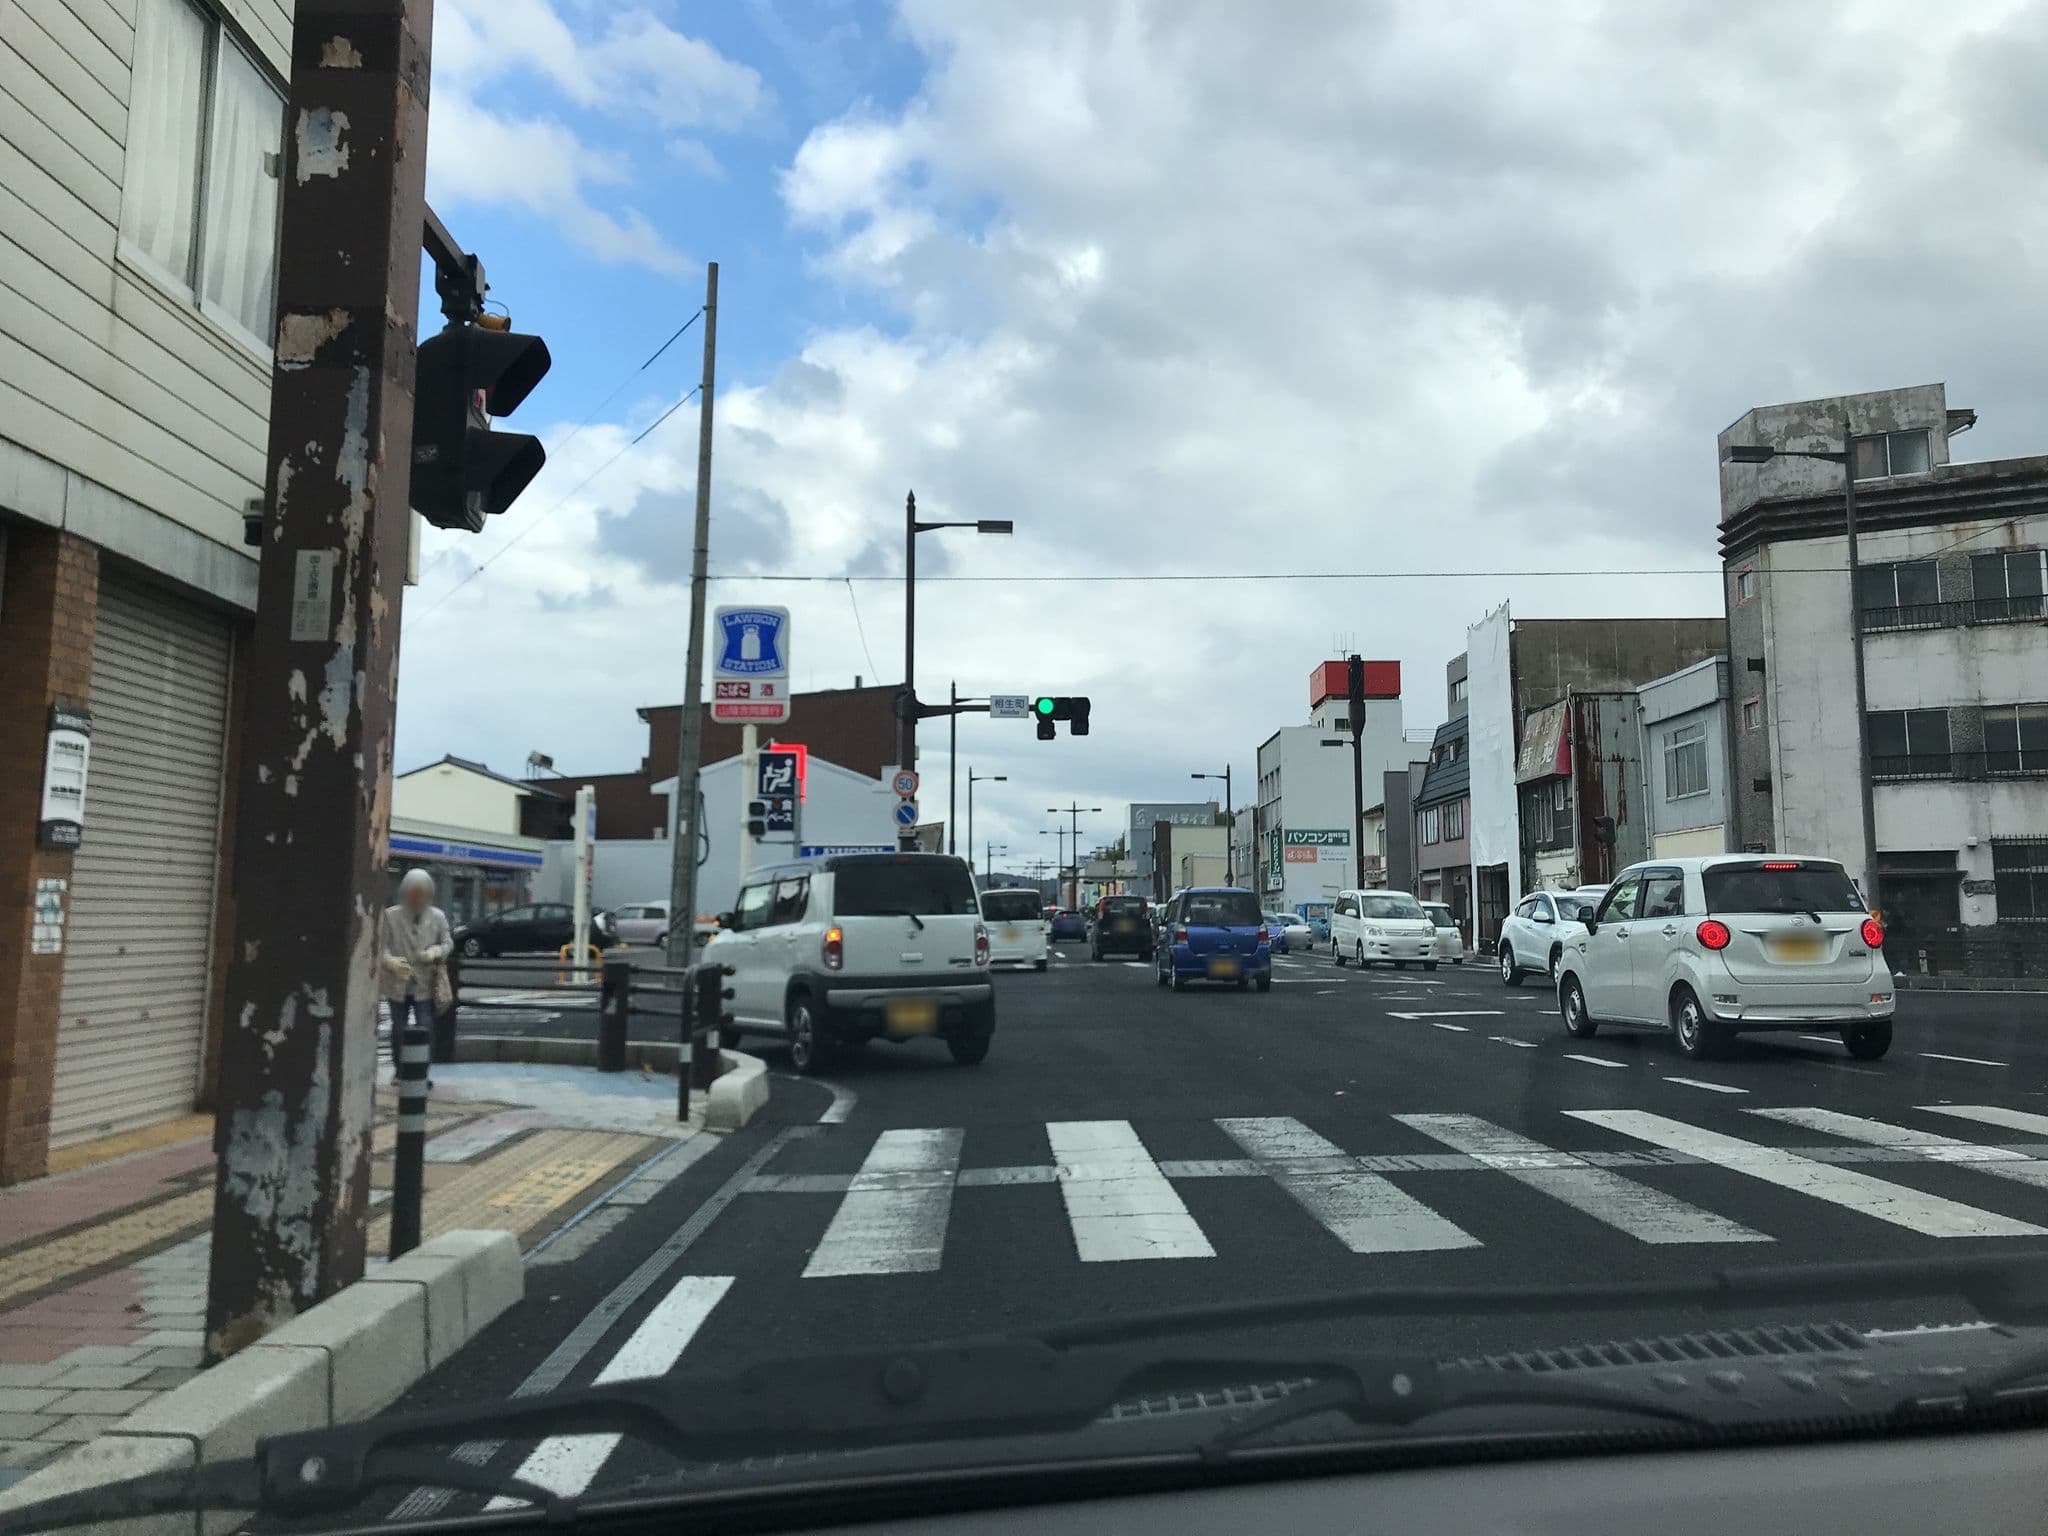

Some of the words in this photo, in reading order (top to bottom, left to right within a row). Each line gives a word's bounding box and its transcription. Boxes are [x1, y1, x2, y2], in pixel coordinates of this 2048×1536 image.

[724, 614, 779, 627] LAWSON
[724, 657, 777, 672] STATION
[717, 683, 749, 697] たばこ
[898, 777, 913, 790] 50
[1287, 831, 1328, 843] パソコン
